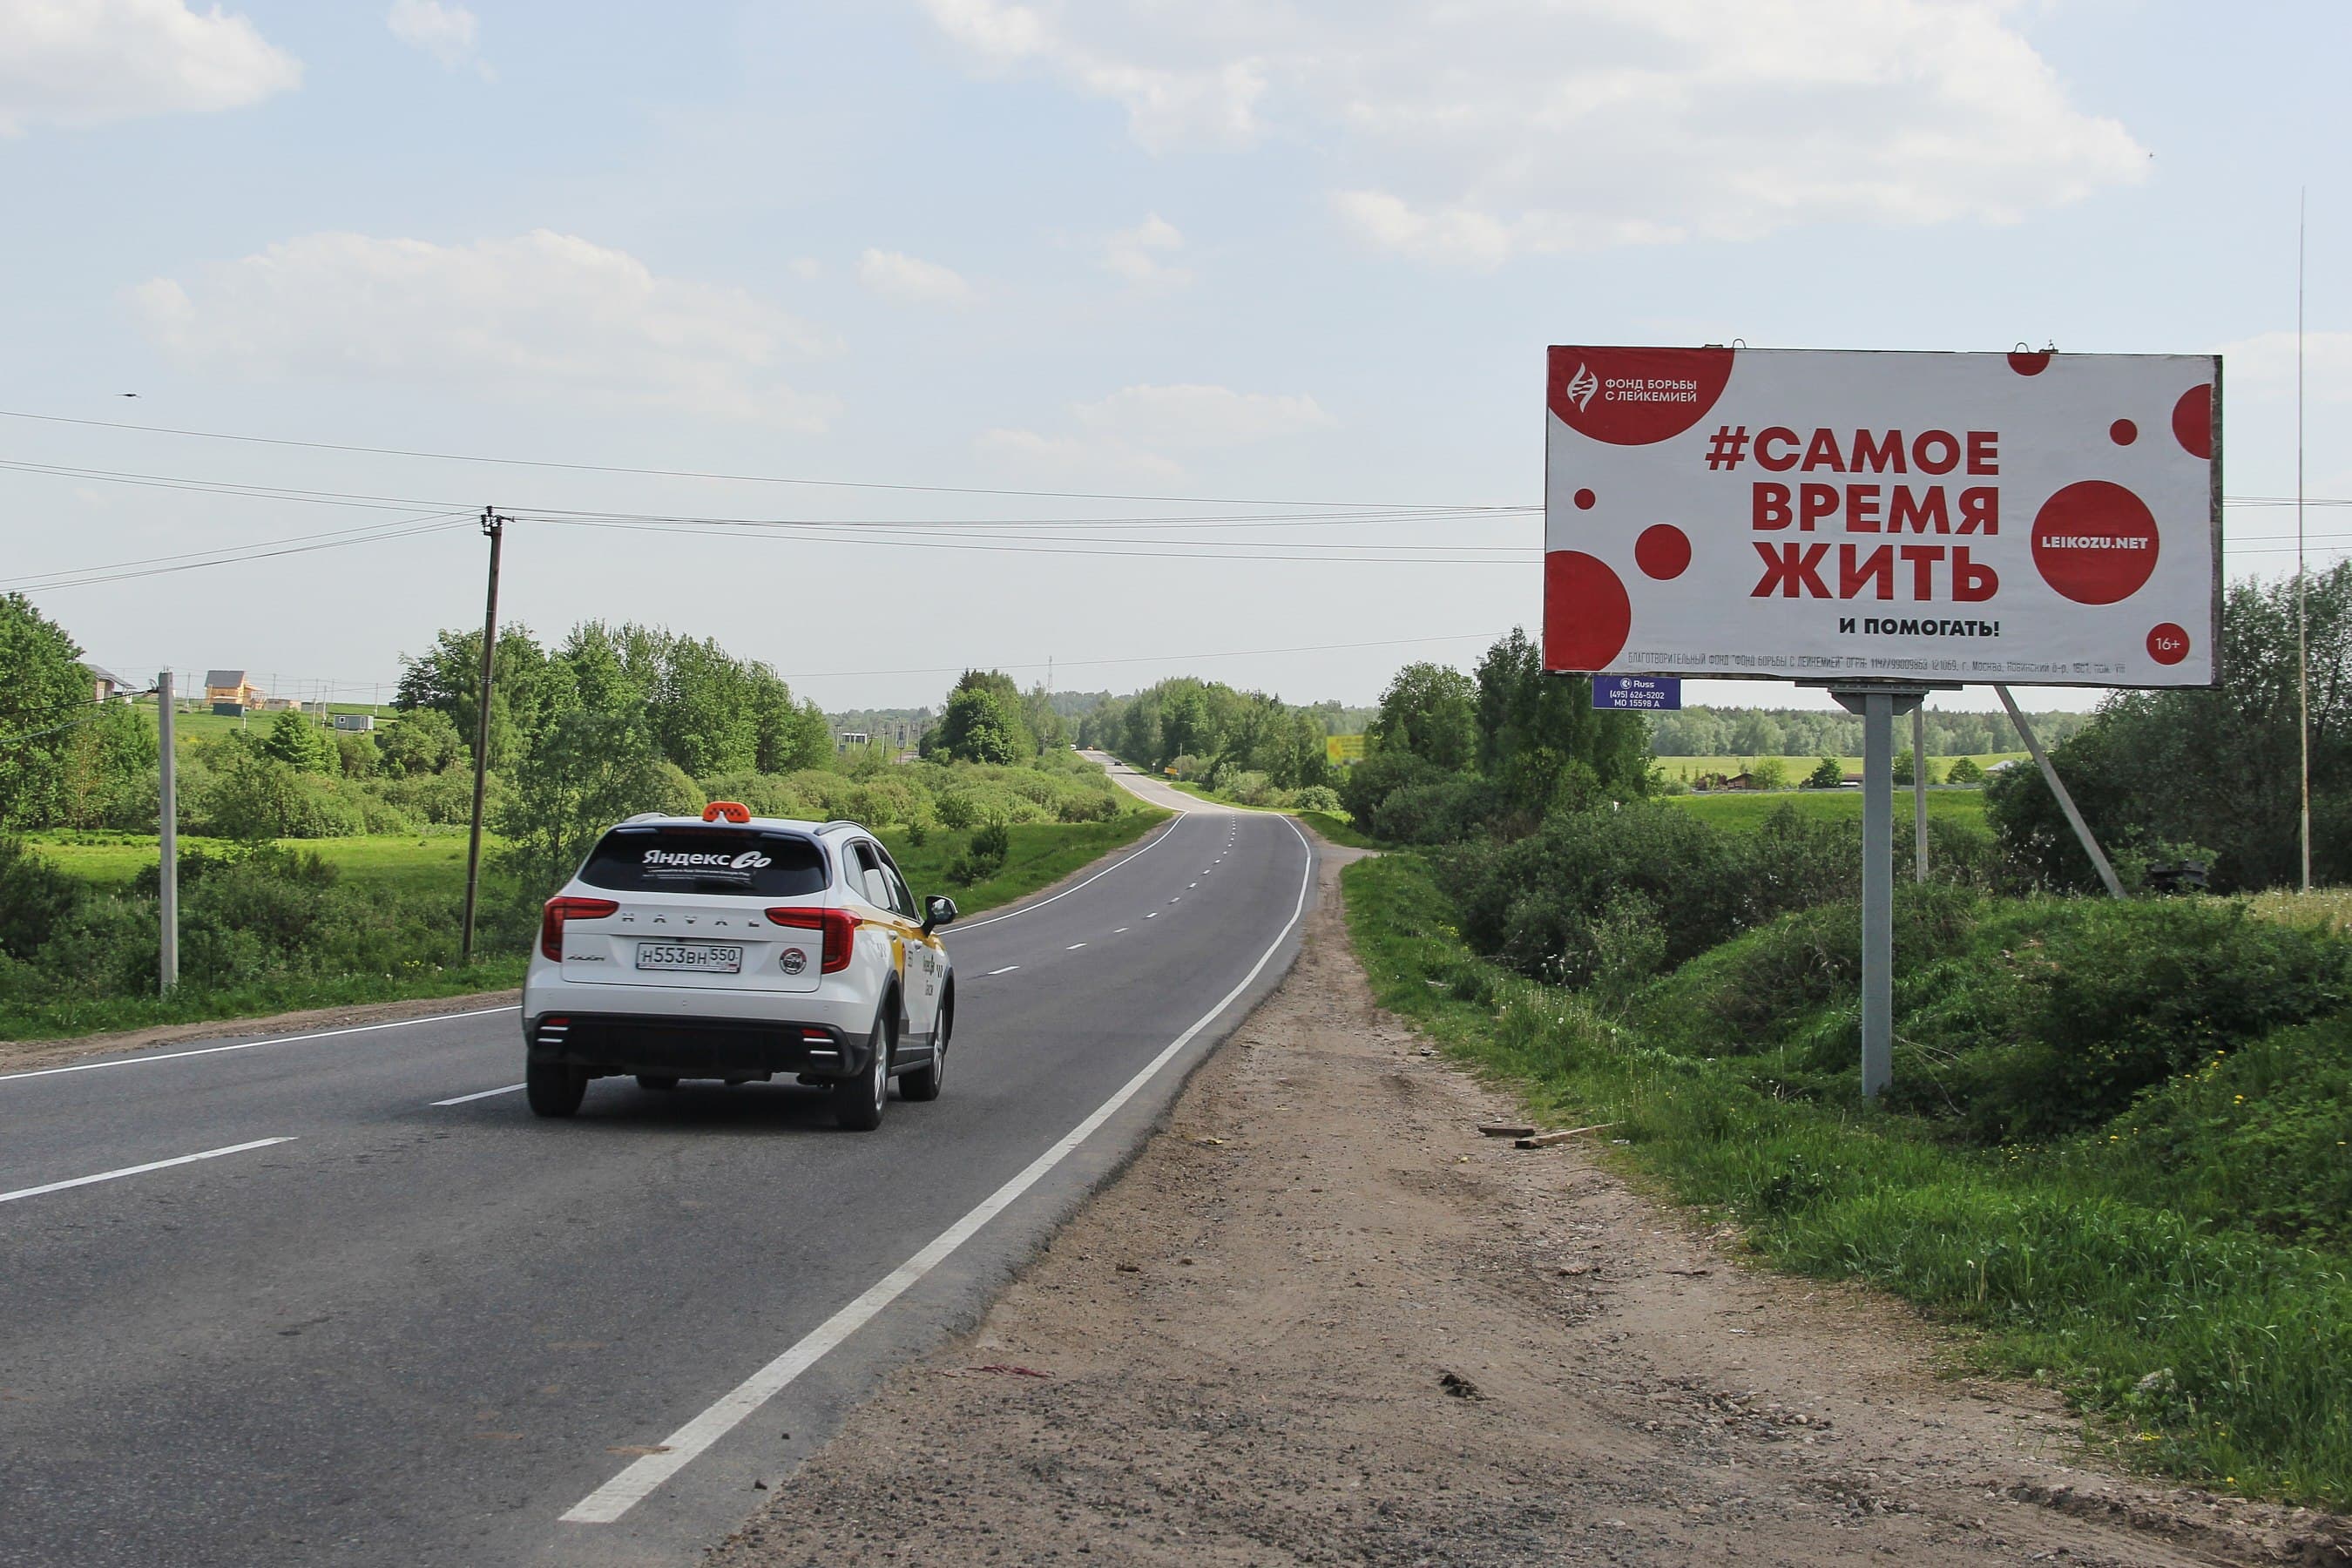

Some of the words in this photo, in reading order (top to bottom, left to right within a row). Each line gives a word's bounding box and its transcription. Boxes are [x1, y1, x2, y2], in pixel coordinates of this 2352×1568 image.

[1605, 378, 1644, 391] ФОНД
[1647, 379, 1697, 391] БОРЬБЫ
[1605, 390, 1615, 402] С
[1618, 389, 1697, 403] ЛЕЙКЕМИЕЙ
[1705, 426, 1998, 476] #САМОЕ
[1753, 482, 1998, 536] ВРЕМЯ
[2042, 536, 2148, 550] LEIKOZU.NET
[1751, 542, 1998, 602] ЖИТЬ
[1839, 618, 1855, 634] И
[1864, 618, 1999, 638] ПОМОГАТЬ!
[2155, 638, 2181, 651] 16+
[1628, 652, 1706, 665] БЛАГОТВОРИТЕЛЬНЫЙ
[1709, 655, 1728, 666] ФОНД
[1758, 655, 1787, 667] БОРЬБЫ
[1610, 690, 1628, 699] (495)
[1630, 691, 1665, 700] 626-5202
[642, 849, 732, 866] Яндекс
[731, 850, 772, 868] Go
[621, 913, 760, 928] HAVAL
[642, 947, 707, 964] Н553ВН
[710, 949, 736, 962] 550
